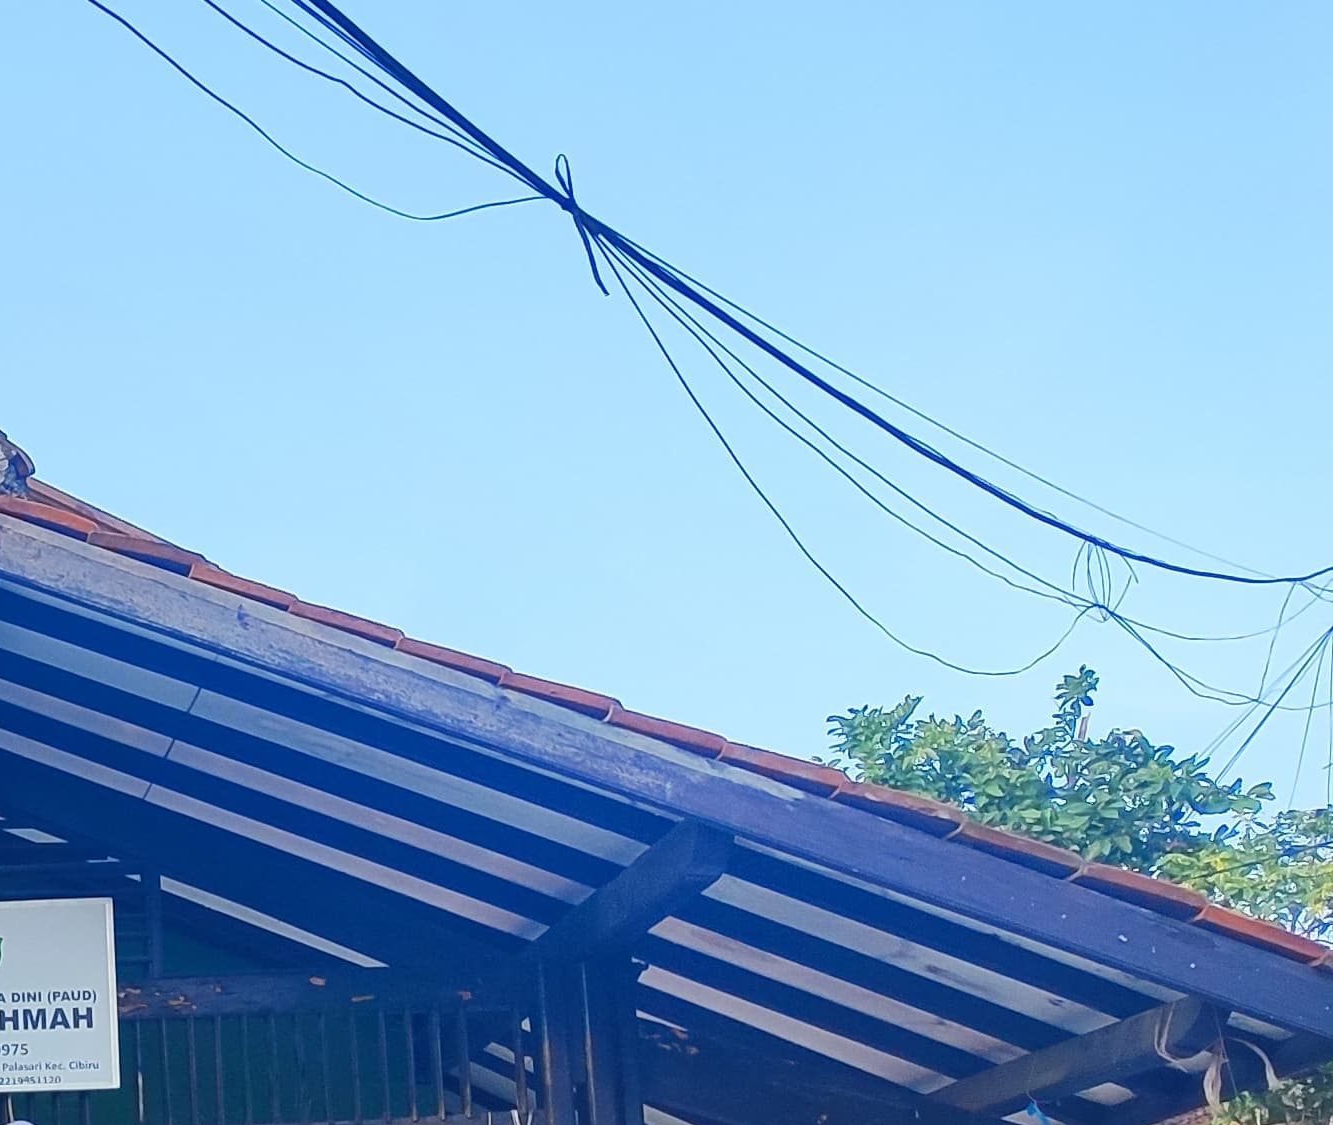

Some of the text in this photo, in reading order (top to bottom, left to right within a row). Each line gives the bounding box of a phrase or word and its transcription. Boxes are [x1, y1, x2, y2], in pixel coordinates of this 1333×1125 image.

[11, 992, 42, 1003] DINI
[47, 990, 97, 1004] (PAUD)
[2, 1061, 42, 1072] Palasari
[45, 1062, 65, 1071] Kec.
[69, 1061, 99, 1070] Cibiru
